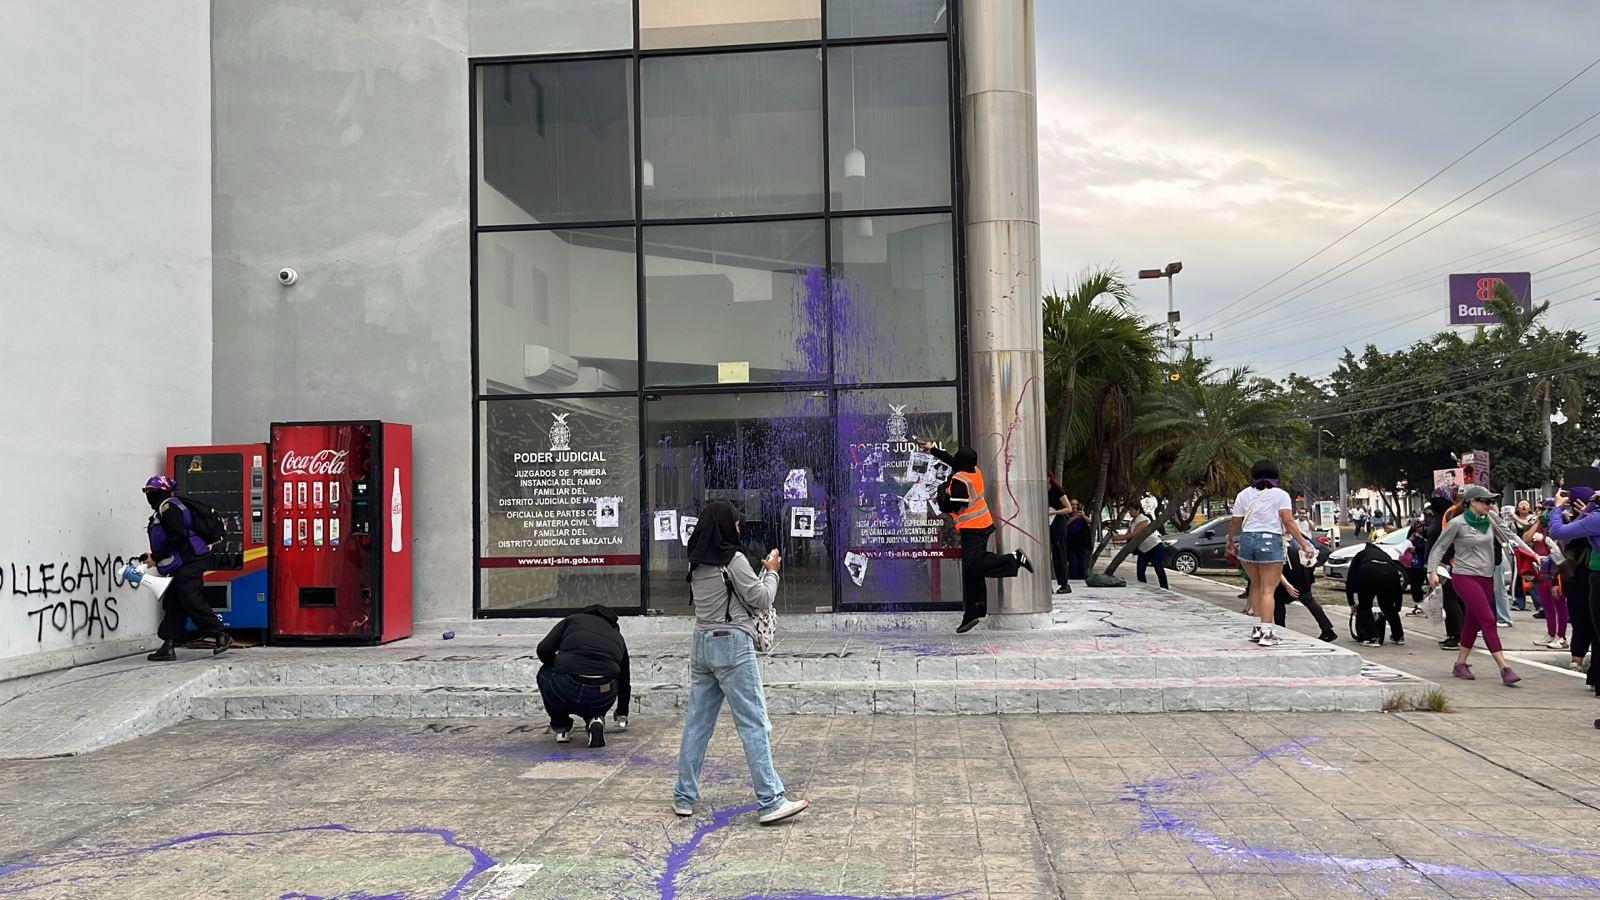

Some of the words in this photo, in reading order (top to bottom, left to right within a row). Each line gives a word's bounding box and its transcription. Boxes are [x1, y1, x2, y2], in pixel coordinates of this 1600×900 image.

[893, 441, 947, 453] JUDIAL
[281, 449, 350, 475] Coca-Cola
[513, 452, 553, 463] PODER
[555, 451, 607, 462] JUDICIAL
[514, 469, 556, 478] JUZGADOS
[559, 469, 570, 477] DE
[573, 468, 607, 476] PRIMERA
[520, 478, 560, 487] INSTANCIA
[561, 478, 576, 486] DEL
[533, 487, 570, 496] FAMILIAR
[571, 487, 587, 495] DEL
[499, 498, 534, 507] DISTRITO
[535, 497, 569, 506] JUDICIAL
[571, 497, 582, 505] DE
[507, 510, 544, 519] OFICIALIA
[544, 510, 555, 518] DE
[556, 509, 586, 518] PARTES
[523, 520, 534, 529] EN
[535, 519, 569, 528] MATERIA
[570, 518, 590, 527] CIVIL
[533, 529, 570, 537] FAMILIAR
[571, 528, 588, 537] DEL
[927, 527, 938, 535] DEL
[498, 540, 533, 549] DISTRITO
[533, 539, 568, 548] JUDICIAL
[569, 538, 580, 547] DE
[582, 535, 624, 546] MAZATLÁN
[518, 556, 605, 567] www.stj-sin.gob.mx
[28, 597, 119, 643] TODAS
